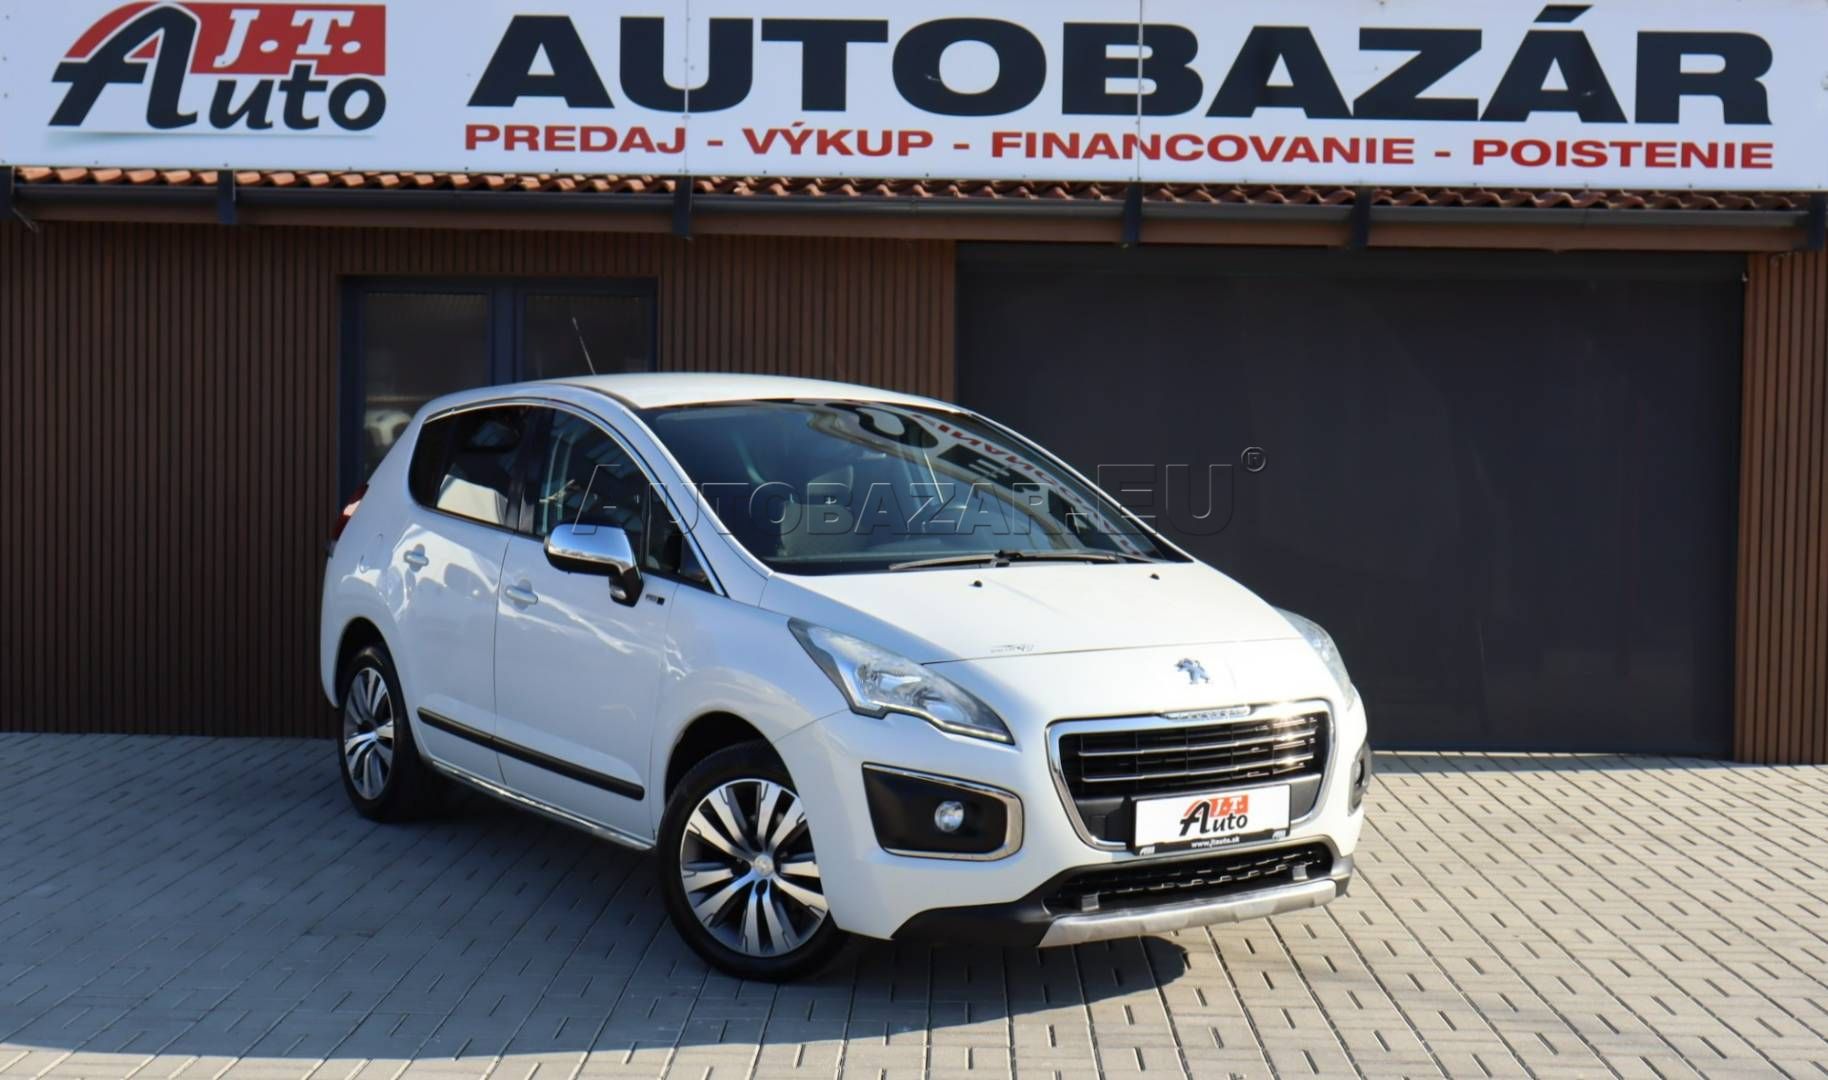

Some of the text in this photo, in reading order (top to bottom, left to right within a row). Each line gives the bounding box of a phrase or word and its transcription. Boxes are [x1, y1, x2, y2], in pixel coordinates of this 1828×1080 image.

[213, 9, 361, 68] J.T.
[467, 4, 1774, 125] AUTOBAZÁR
[48, 6, 387, 131] Auto
[465, 124, 687, 153] PREDAJ
[743, 121, 934, 157] VÝKUP
[991, 131, 1414, 164] FINANCOVANIE
[1473, 139, 1774, 169] POISTENIE
[1179, 801, 1248, 837] Auto
